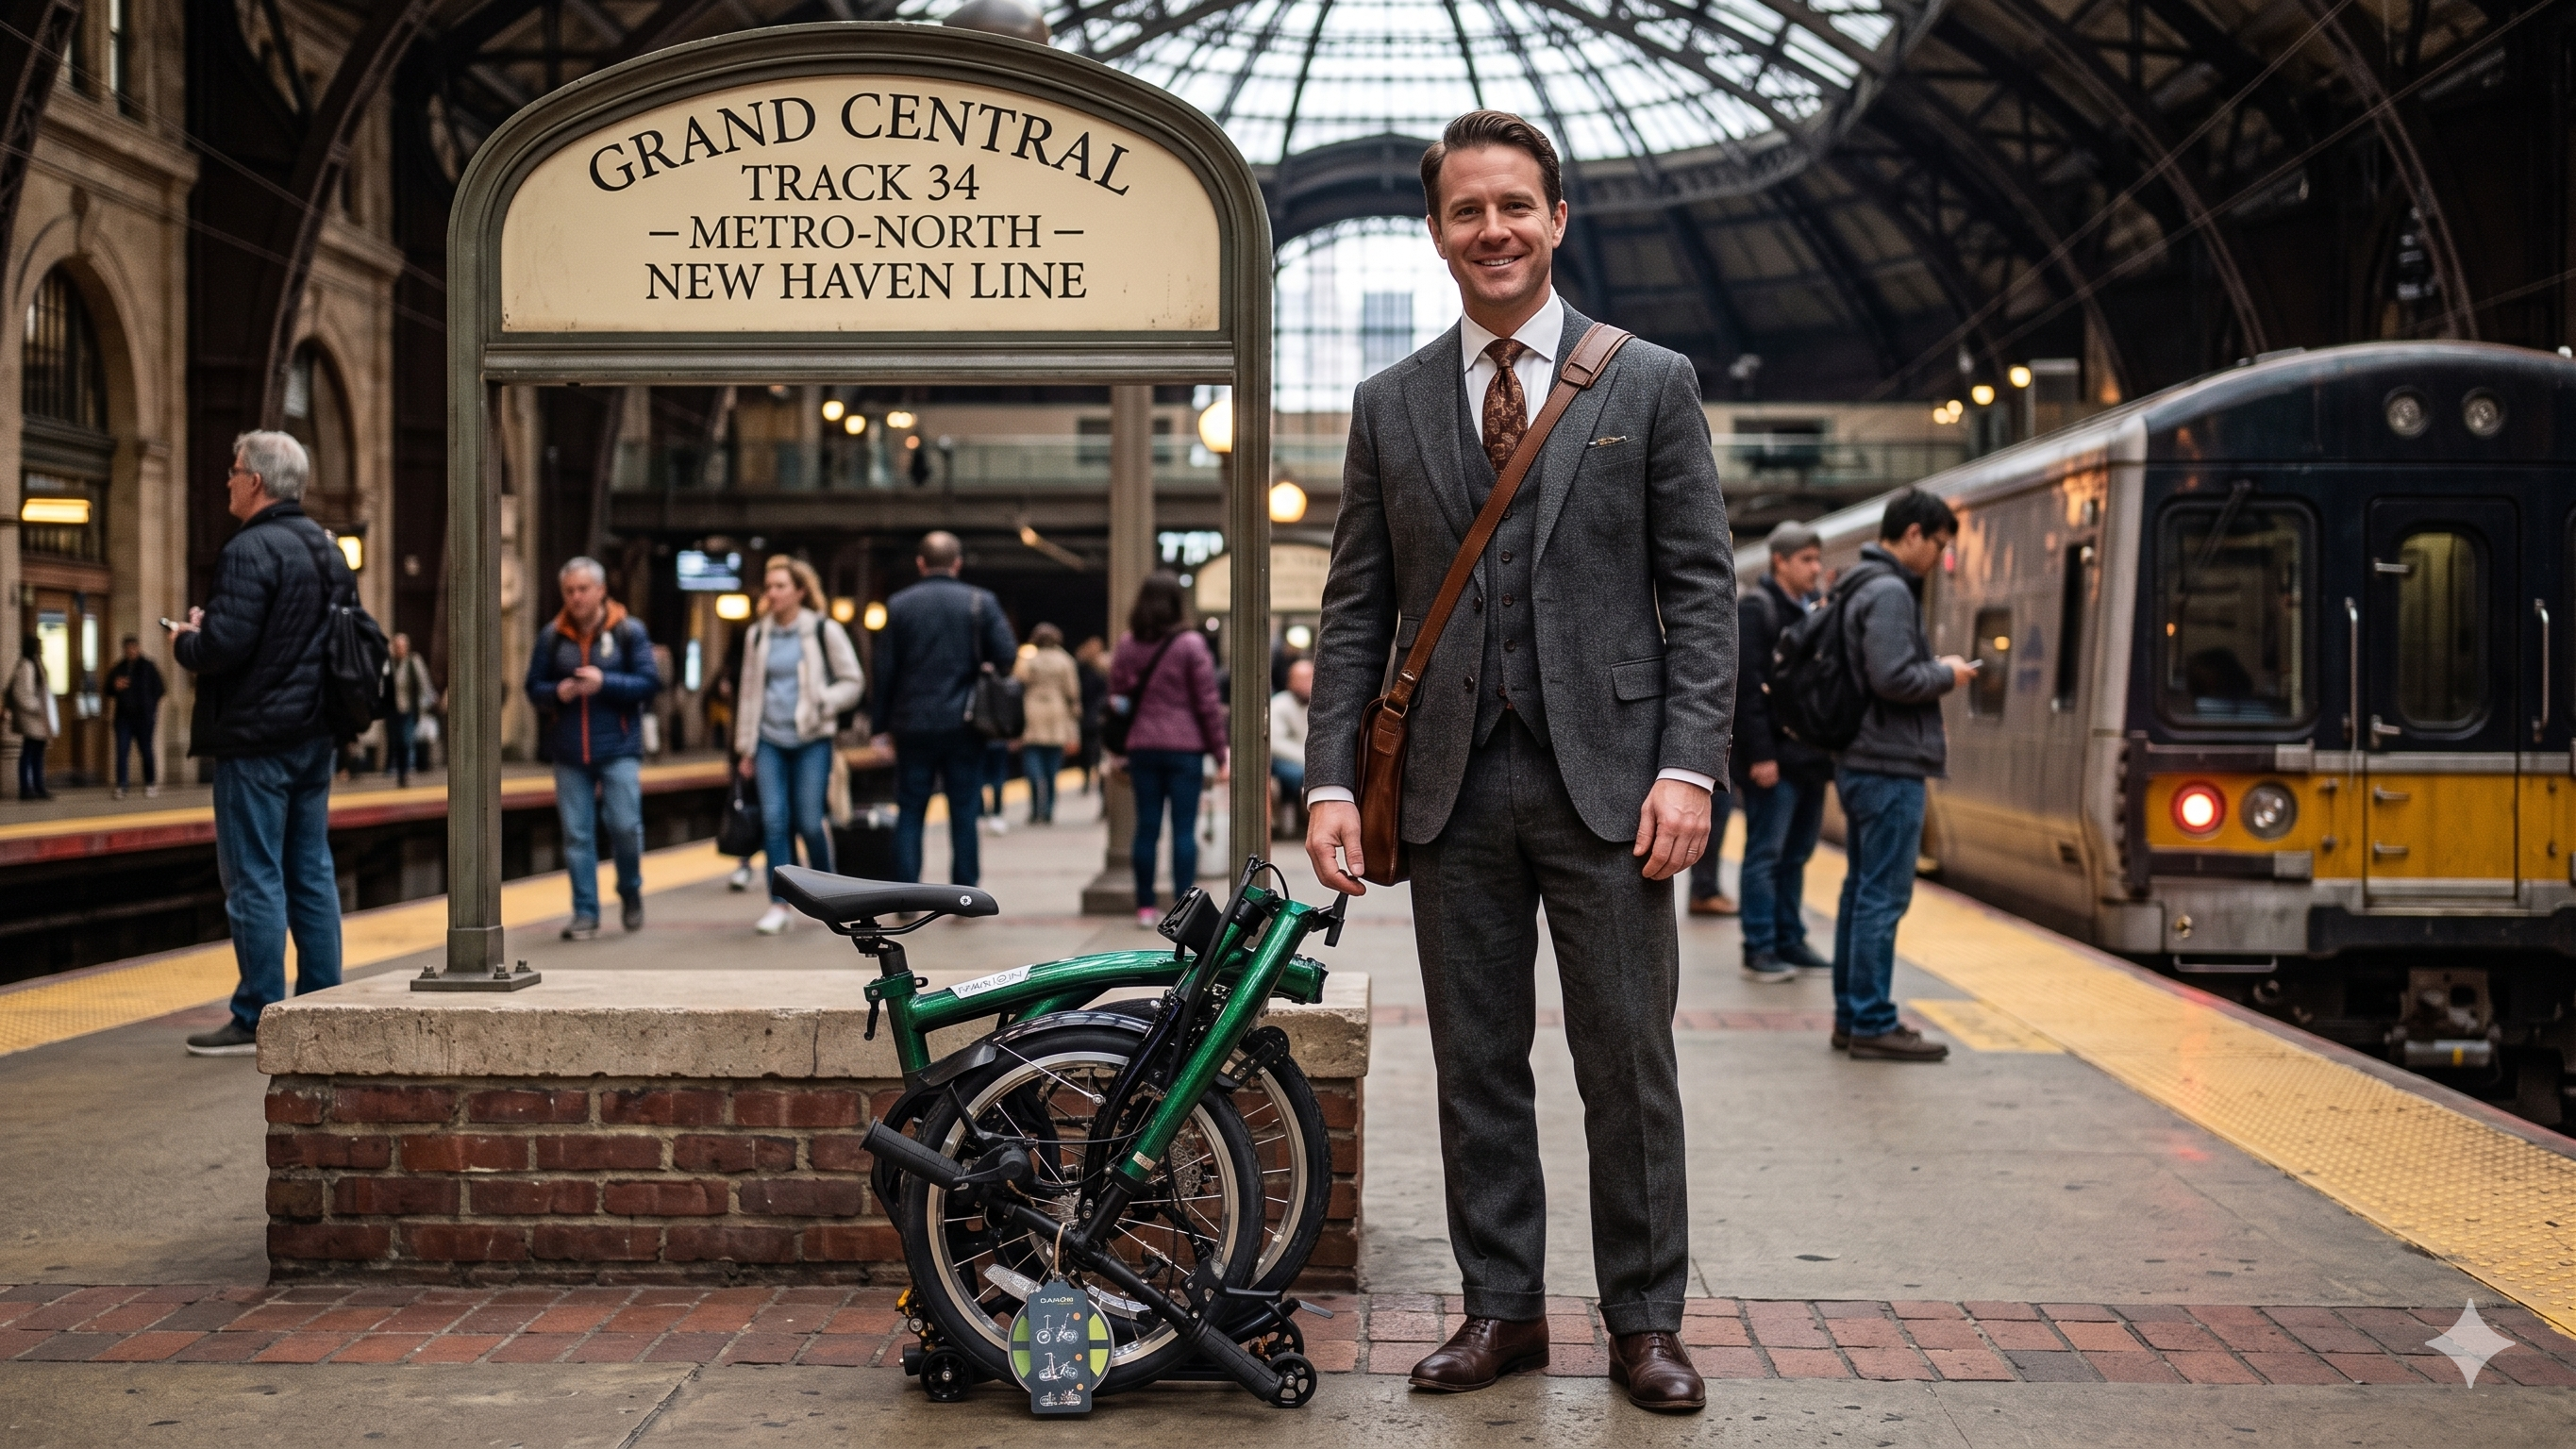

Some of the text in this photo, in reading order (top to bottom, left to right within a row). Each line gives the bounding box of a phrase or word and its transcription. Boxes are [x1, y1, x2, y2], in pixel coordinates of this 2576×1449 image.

[588, 92, 1131, 196] GRAND CENTRAL
[740, 163, 980, 202] TRACK 34
[689, 214, 1042, 250] METRO-NORTH
[644, 262, 1087, 301] NEW HAVEN LINE
